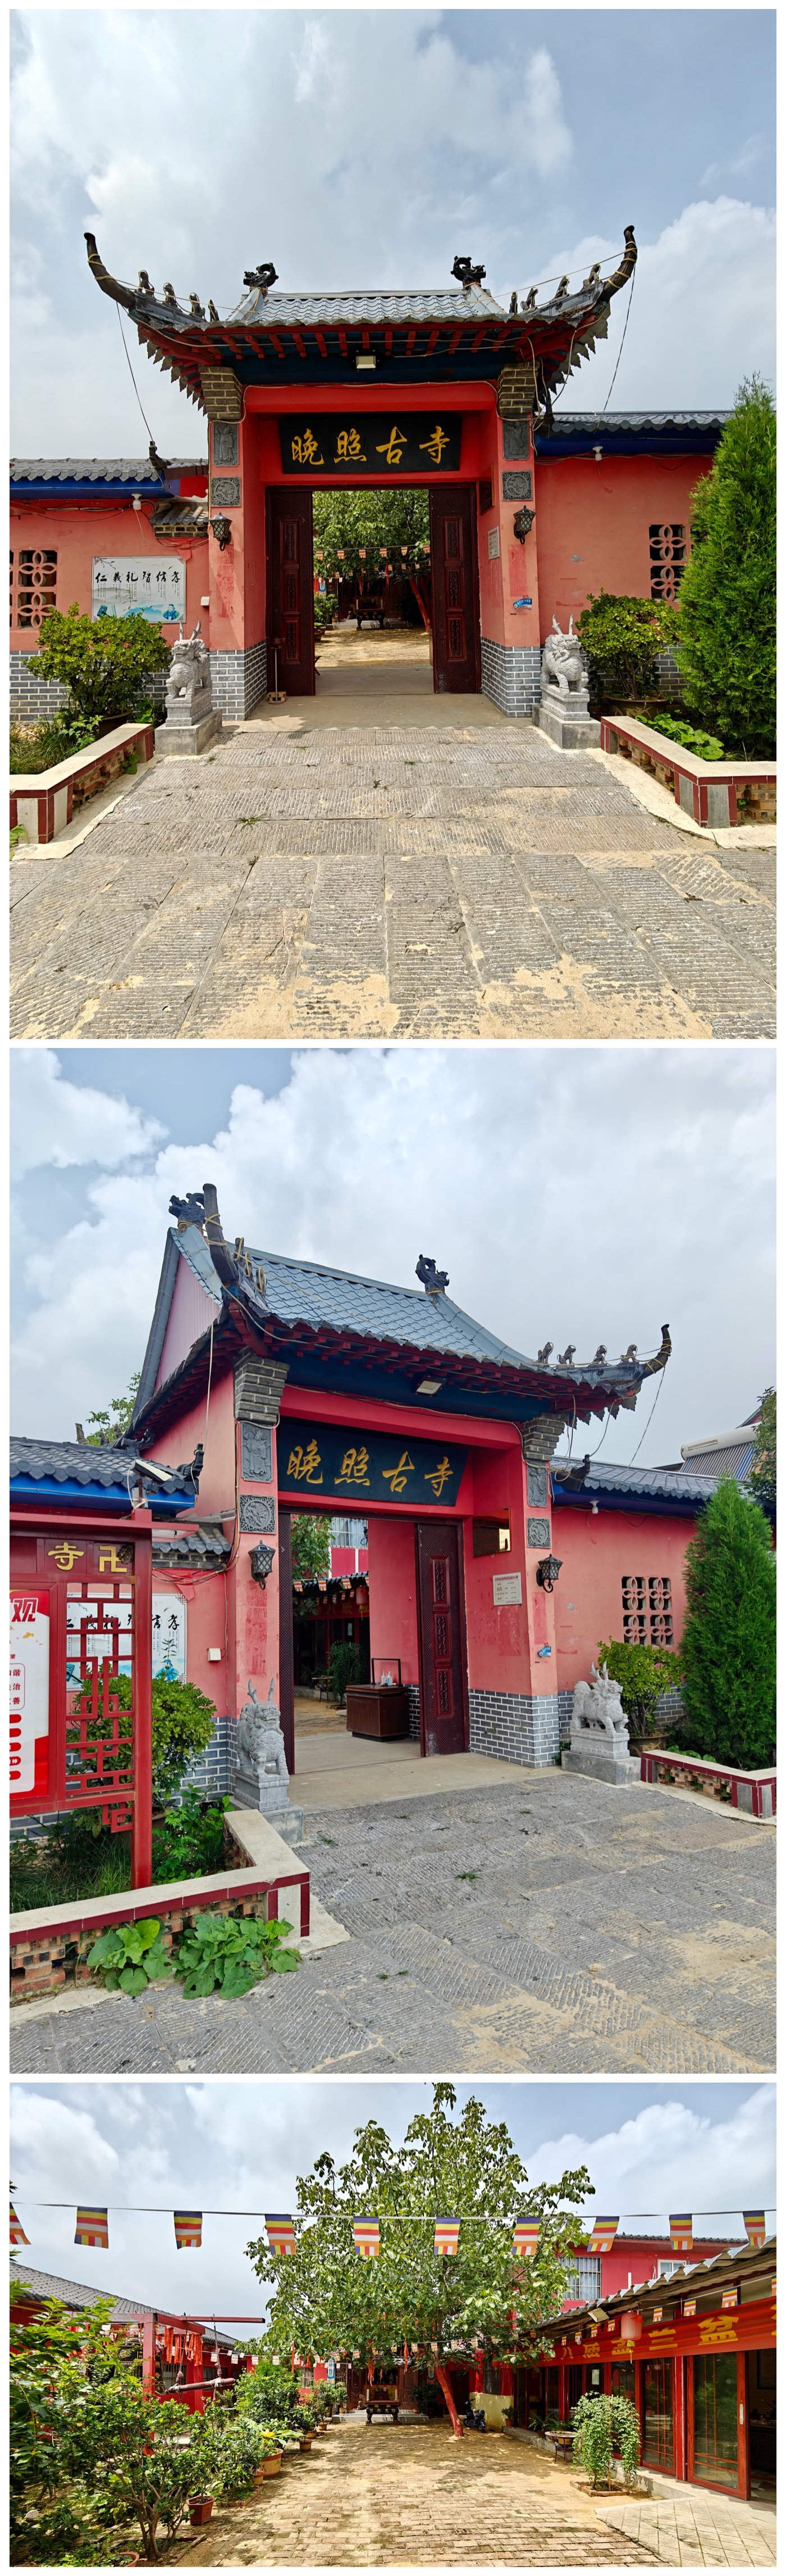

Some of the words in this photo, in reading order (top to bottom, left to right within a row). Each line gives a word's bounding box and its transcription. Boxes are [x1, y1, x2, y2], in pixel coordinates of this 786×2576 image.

[291, 425, 450, 465] 晚照古寺
[286, 1438, 454, 1497] 晚照古寺
[48, 1541, 85, 1571] 寺
[11, 1598, 38, 1622] 观
